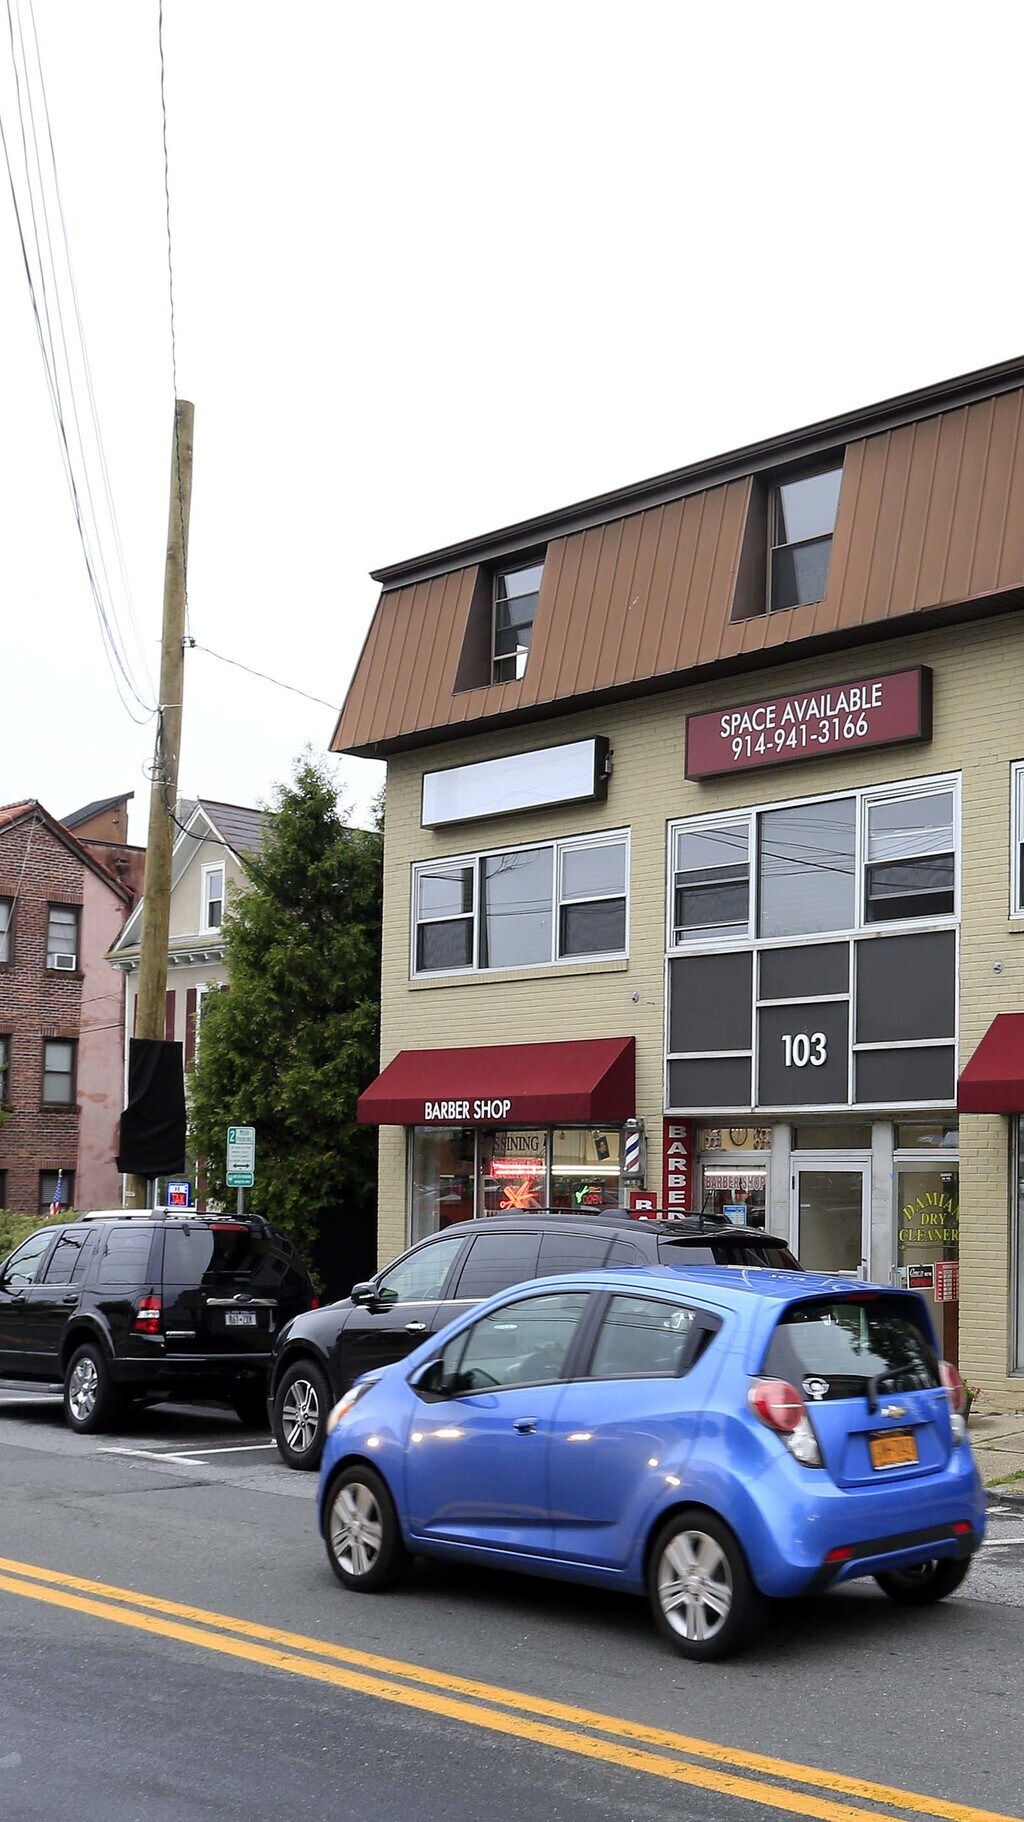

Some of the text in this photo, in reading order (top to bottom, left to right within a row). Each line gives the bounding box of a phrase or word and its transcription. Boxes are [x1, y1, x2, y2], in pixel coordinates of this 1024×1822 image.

[720, 683, 883, 738] SPACE AVAILABLE
[731, 711, 869, 761] 914-941-3166
[781, 1032, 828, 1067] 103
[424, 1099, 511, 1120] BARBER SHOP
[229, 1129, 236, 1142] 2
[492, 1135, 539, 1152] SSINING
[705, 1176, 766, 1191] BARBER SHOP
[921, 1213, 947, 1225] DRY
